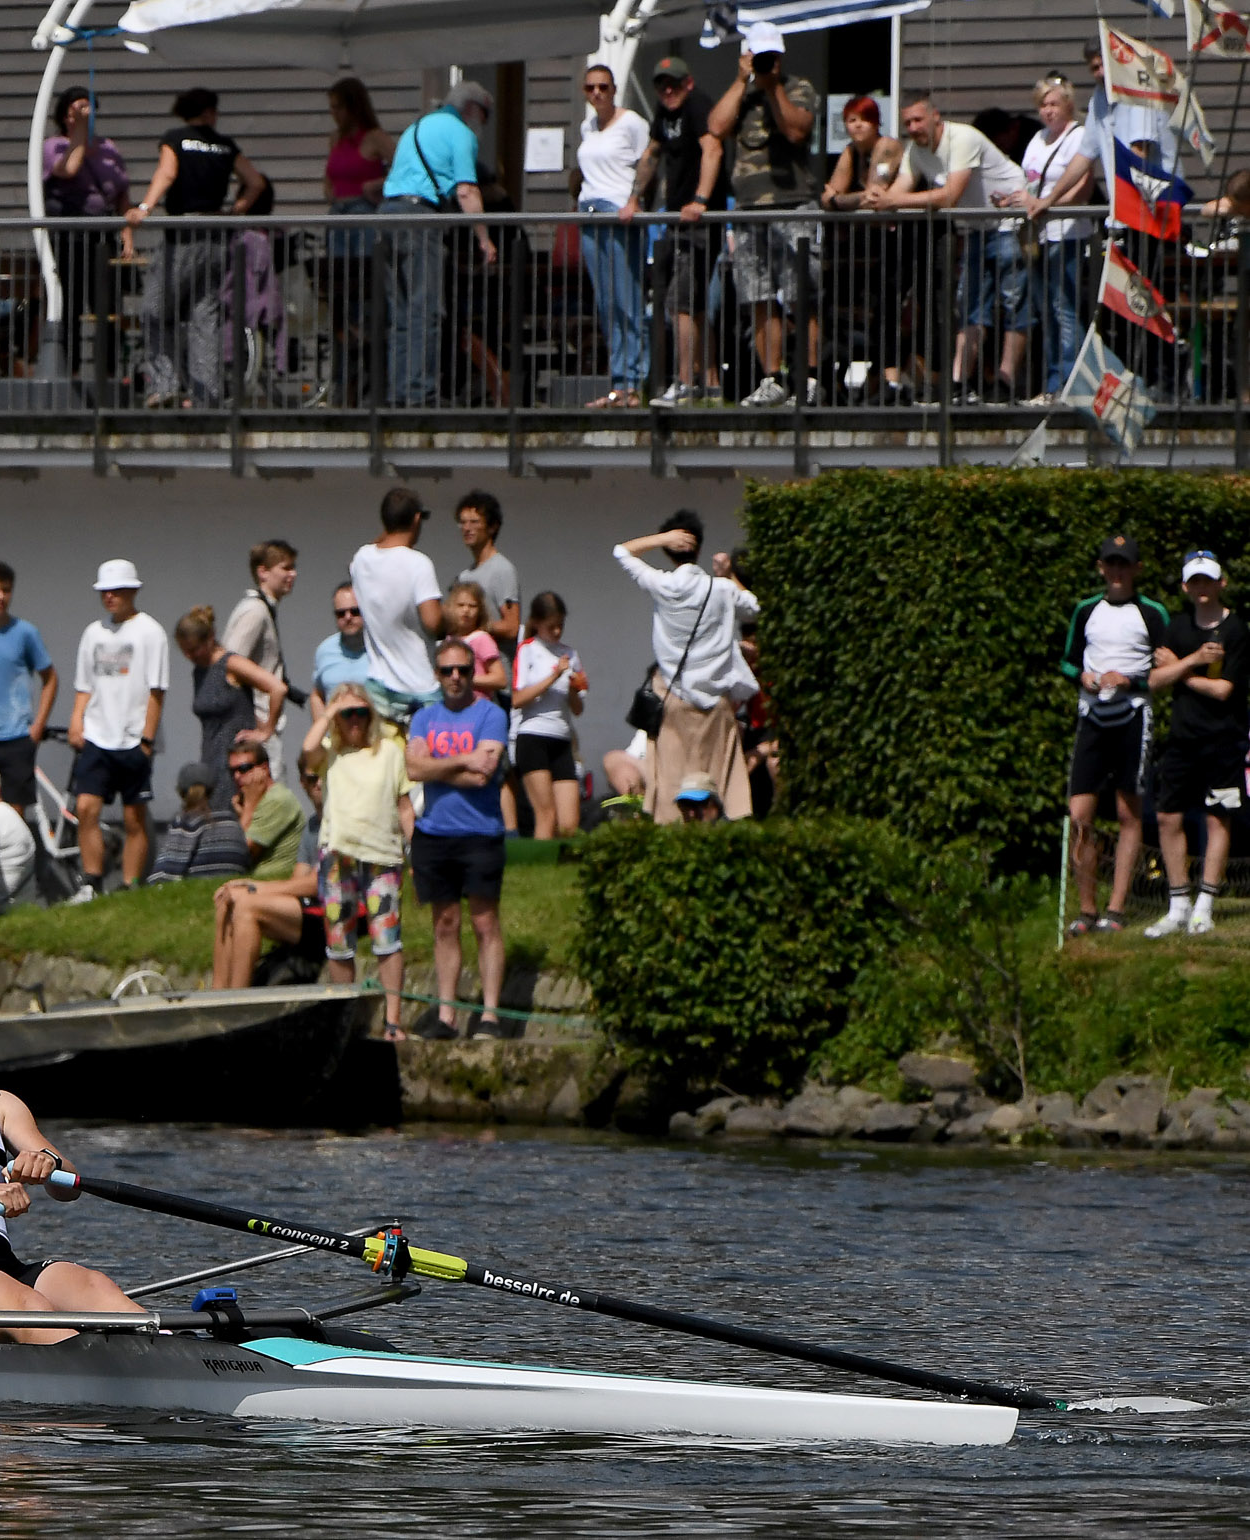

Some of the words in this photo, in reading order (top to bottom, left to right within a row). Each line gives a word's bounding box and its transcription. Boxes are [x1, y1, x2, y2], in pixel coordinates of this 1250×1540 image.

[271, 1225, 337, 1247] concept
[339, 1240, 350, 1250] 2
[483, 1270, 580, 1306] besselrc.de
[202, 1359, 266, 1377] KANGHUA
